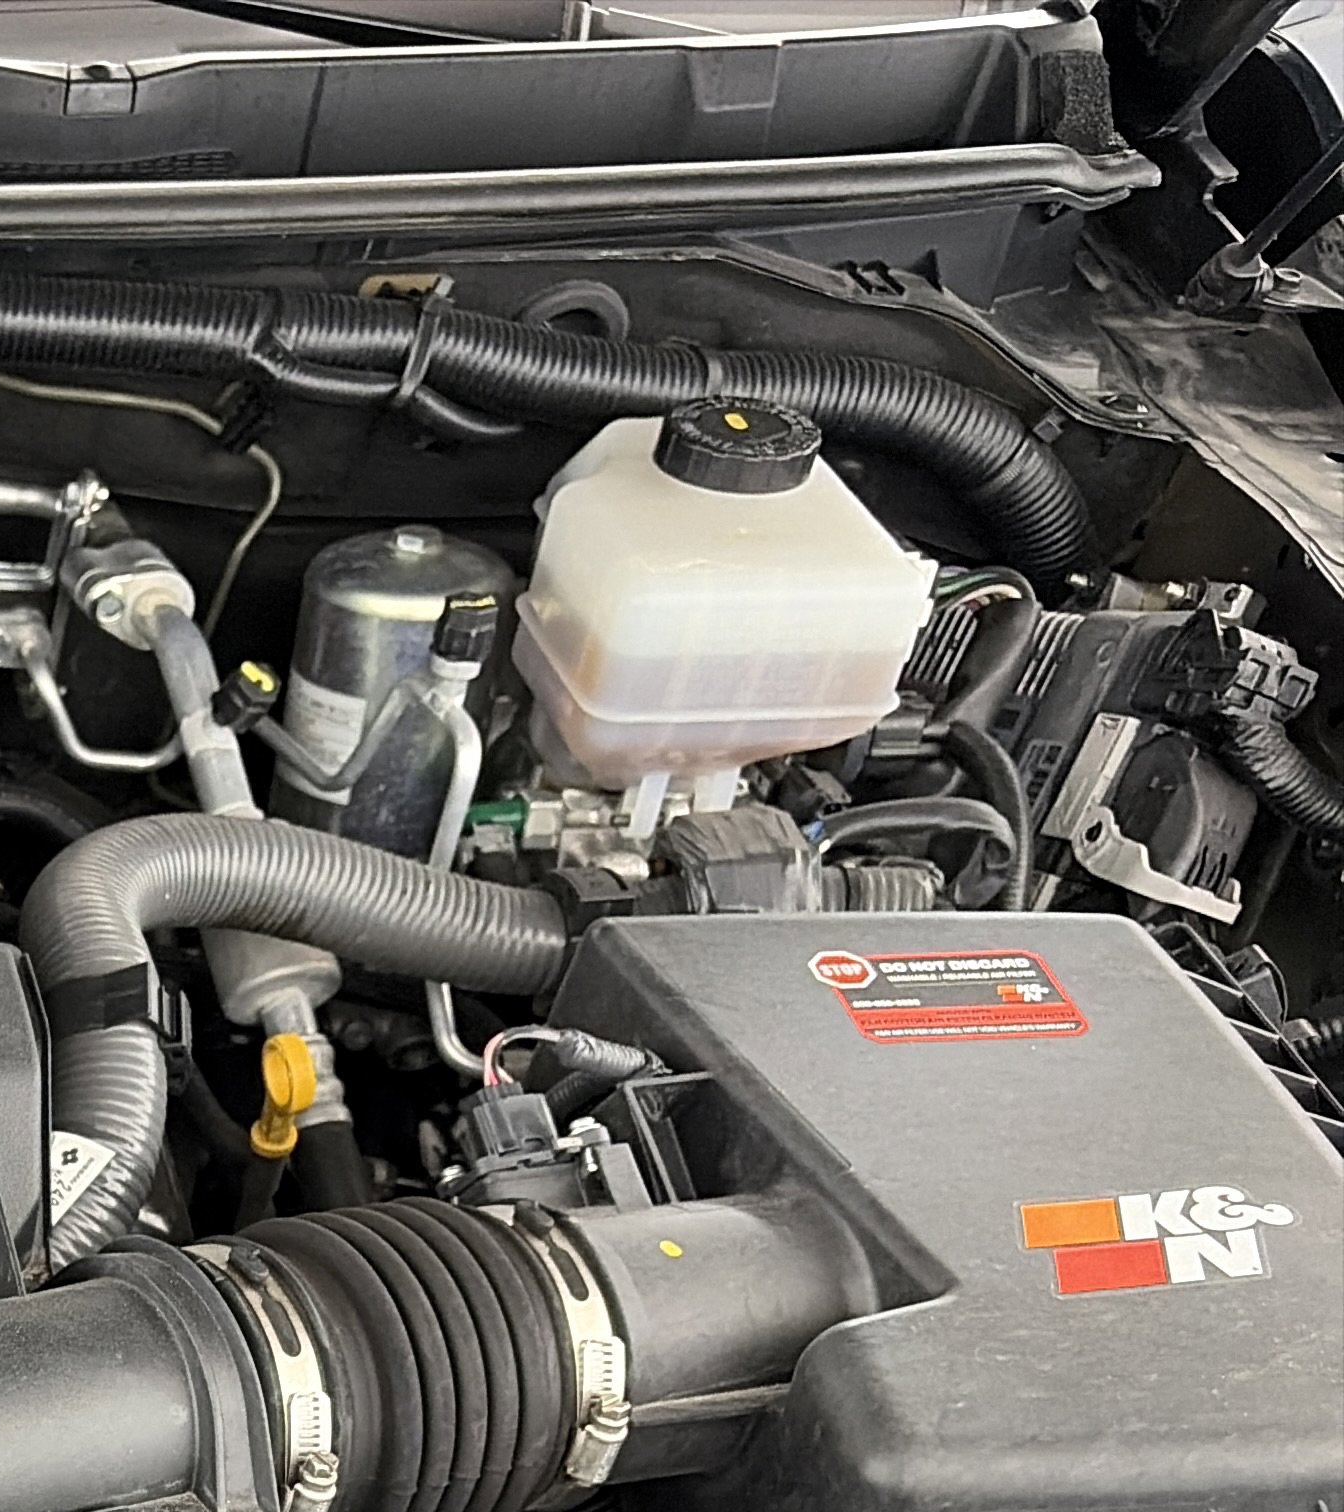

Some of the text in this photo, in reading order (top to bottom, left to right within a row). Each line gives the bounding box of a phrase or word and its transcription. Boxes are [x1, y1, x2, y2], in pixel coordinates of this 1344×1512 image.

[818, 963, 863, 977] STOP
[878, 957, 1031, 973] DO NOT DISCARD
